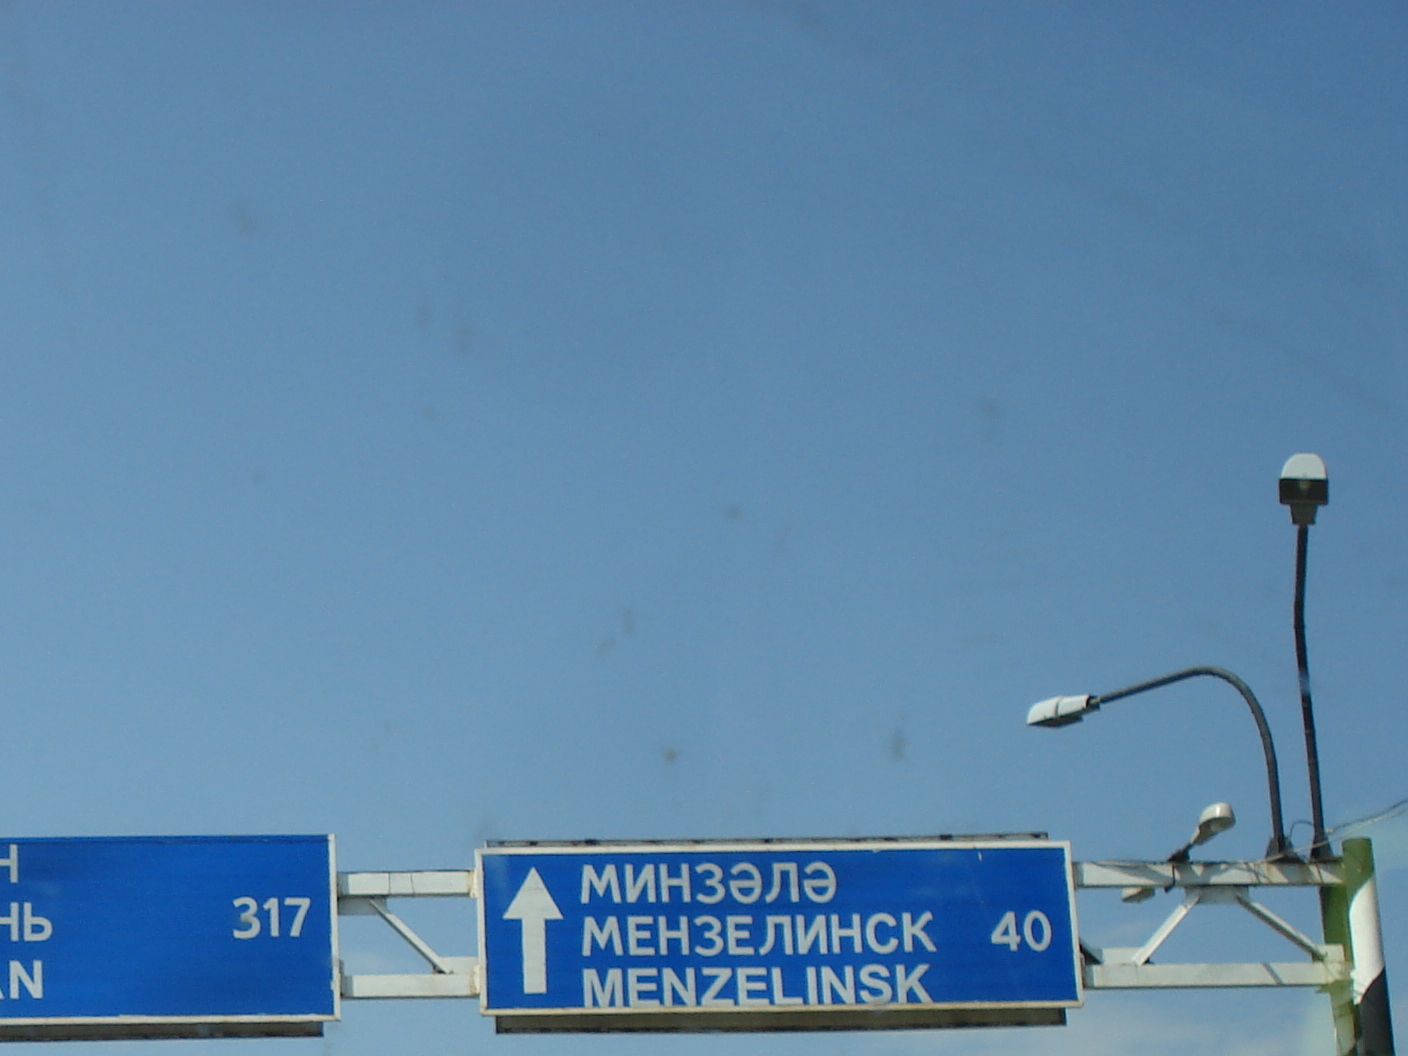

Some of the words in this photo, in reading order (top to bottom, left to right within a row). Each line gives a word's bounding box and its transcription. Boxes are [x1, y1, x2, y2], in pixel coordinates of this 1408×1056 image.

[580, 862, 838, 904] МИНЗӘЛӘ
[233, 896, 311, 939] 317
[582, 911, 937, 957] МЕНЗЕЛИНСК
[991, 910, 1053, 952] 40
[581, 963, 935, 1008] MENZELINSK
